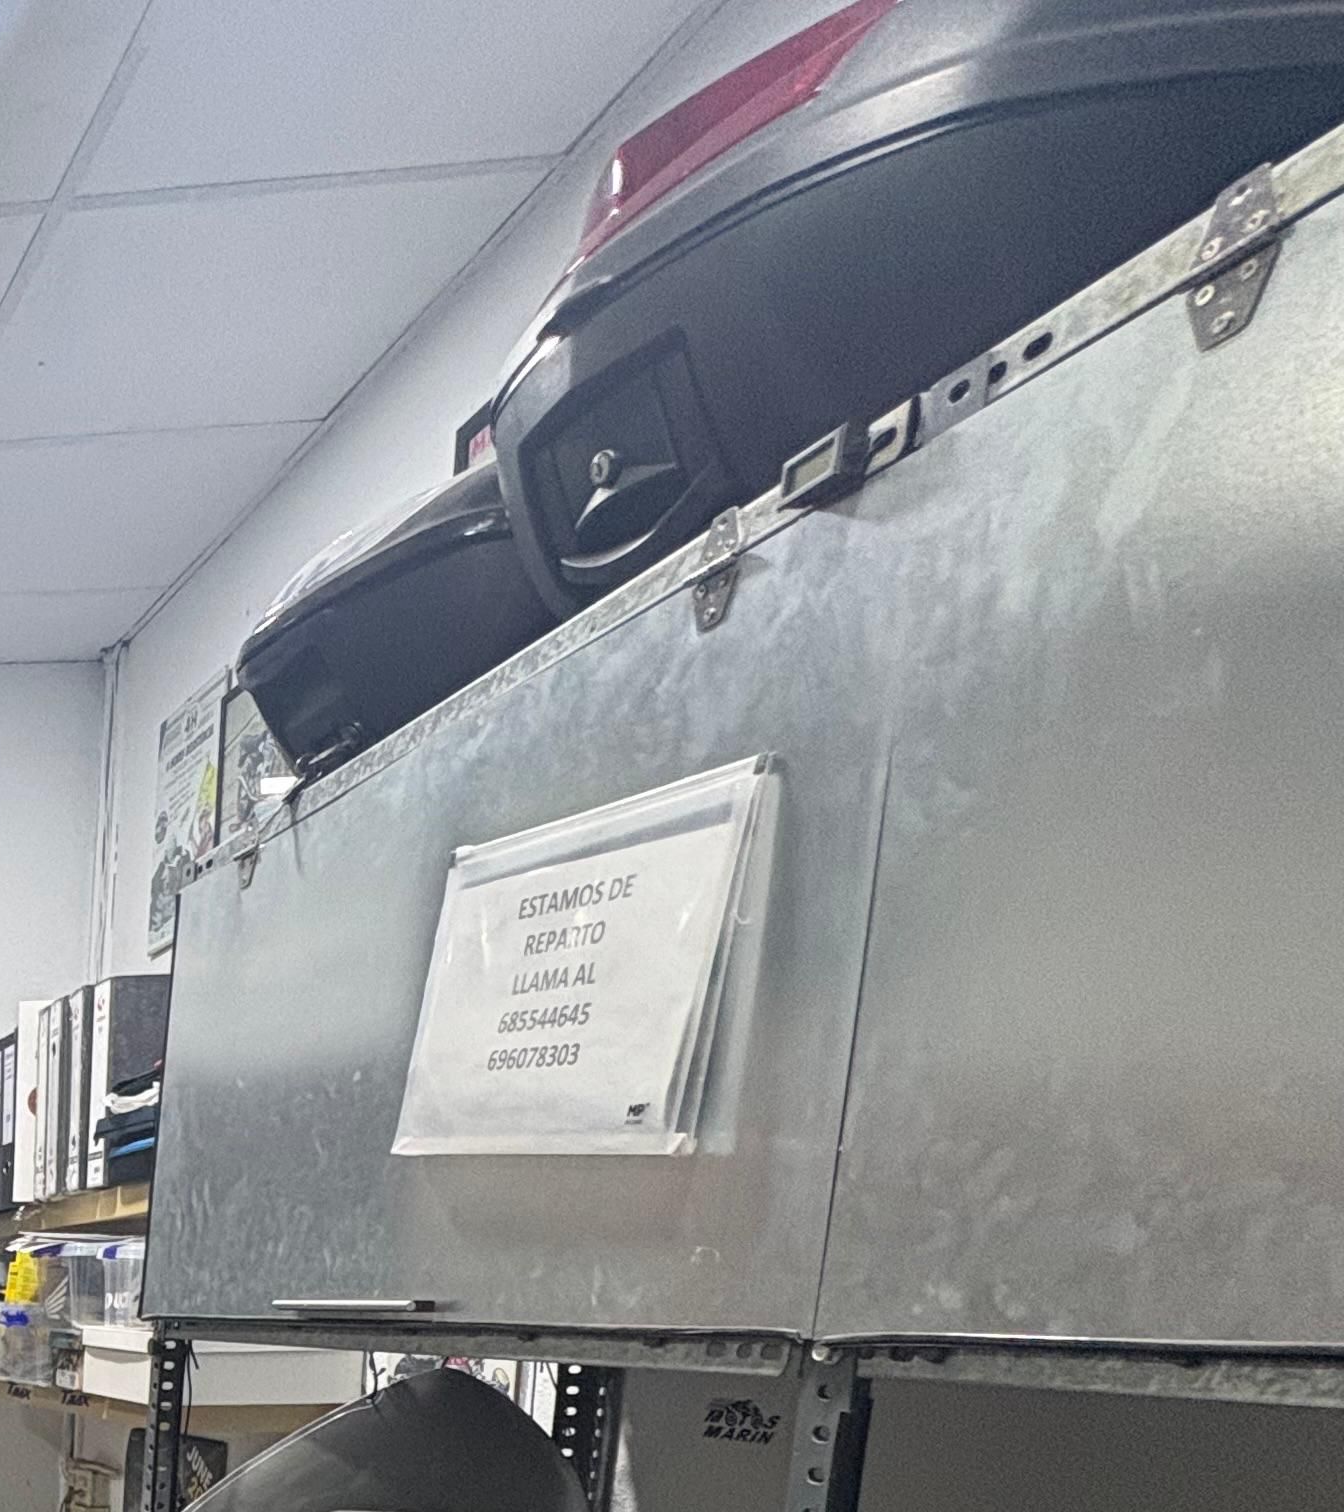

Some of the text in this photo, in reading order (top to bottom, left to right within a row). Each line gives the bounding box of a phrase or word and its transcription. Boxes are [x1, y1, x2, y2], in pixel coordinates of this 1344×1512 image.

[518, 873, 638, 921] ESTAMOS DE
[511, 962, 597, 996] LLAMA AL
[497, 1002, 593, 1034] 685544645
[487, 1043, 582, 1072] 696078303
[703, 1426, 774, 1445] MARIN
